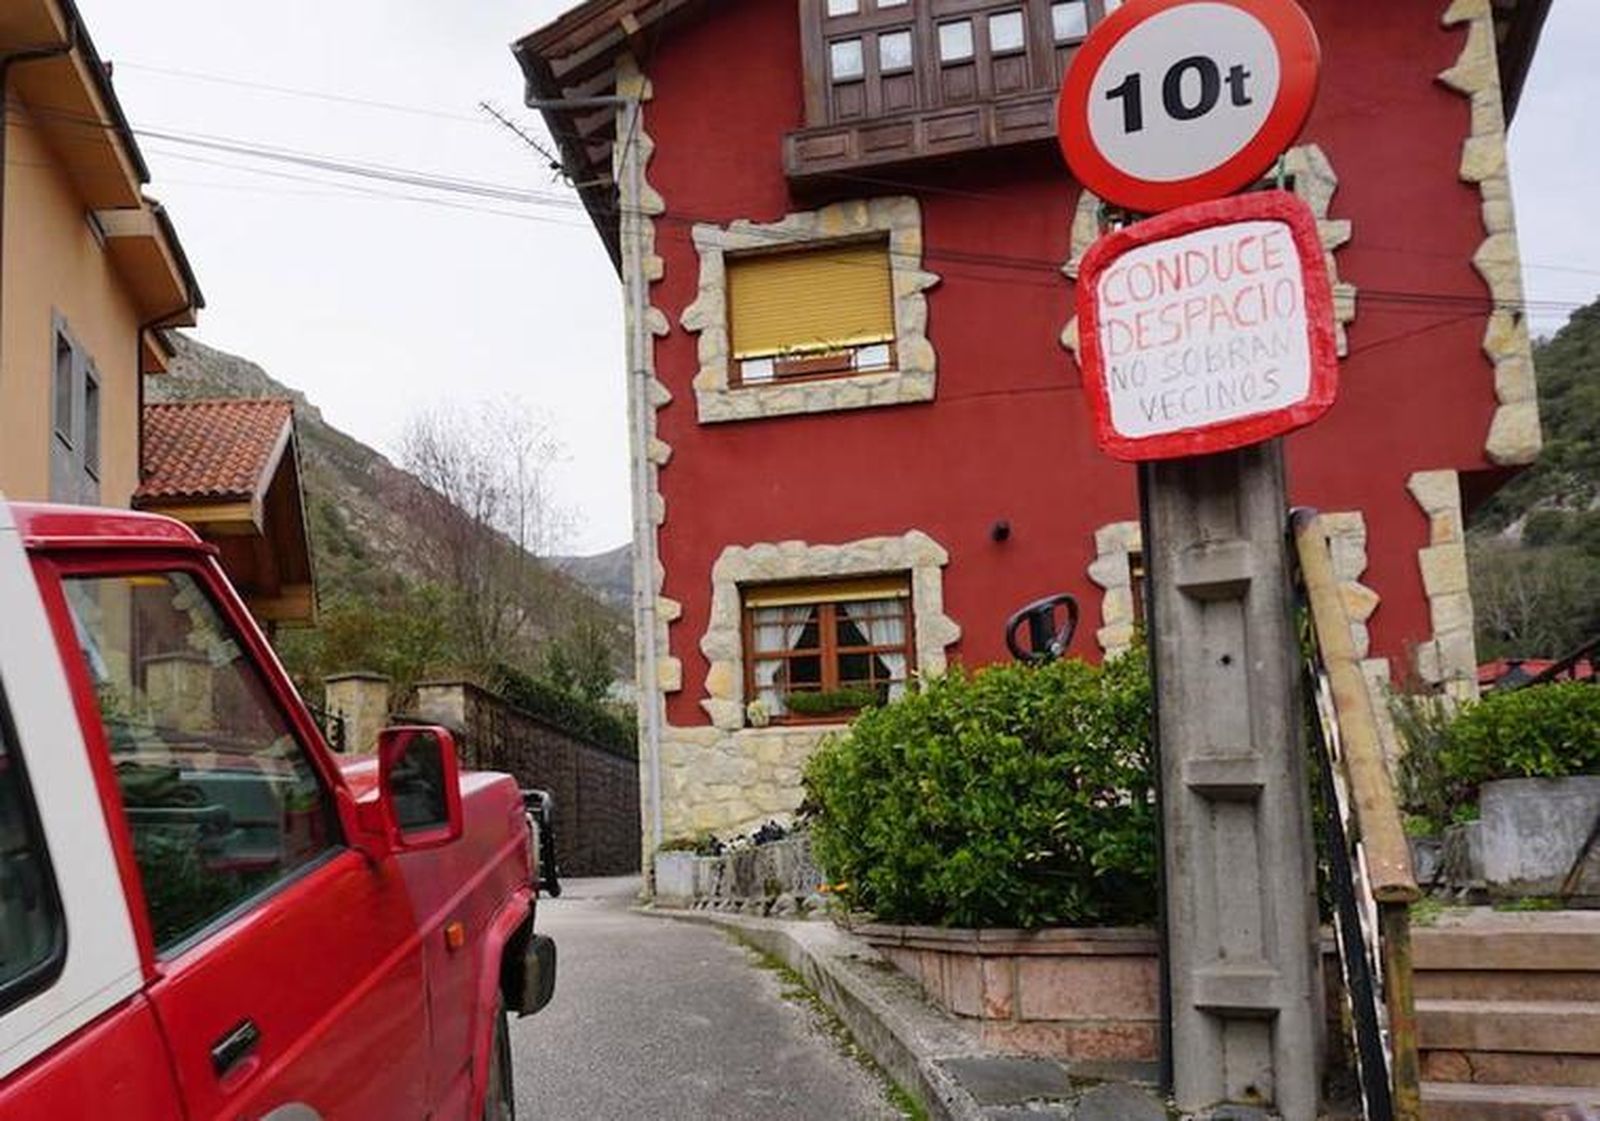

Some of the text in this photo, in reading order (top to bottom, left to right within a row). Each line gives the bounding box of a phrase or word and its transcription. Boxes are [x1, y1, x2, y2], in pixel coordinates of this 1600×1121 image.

[1105, 55, 1252, 134] 10t
[1103, 230, 1284, 307] CONDUCE
[1106, 278, 1296, 356] DESPACIO
[1111, 331, 1290, 392] NO SOBRAN
[1139, 368, 1280, 422] VECINOS
